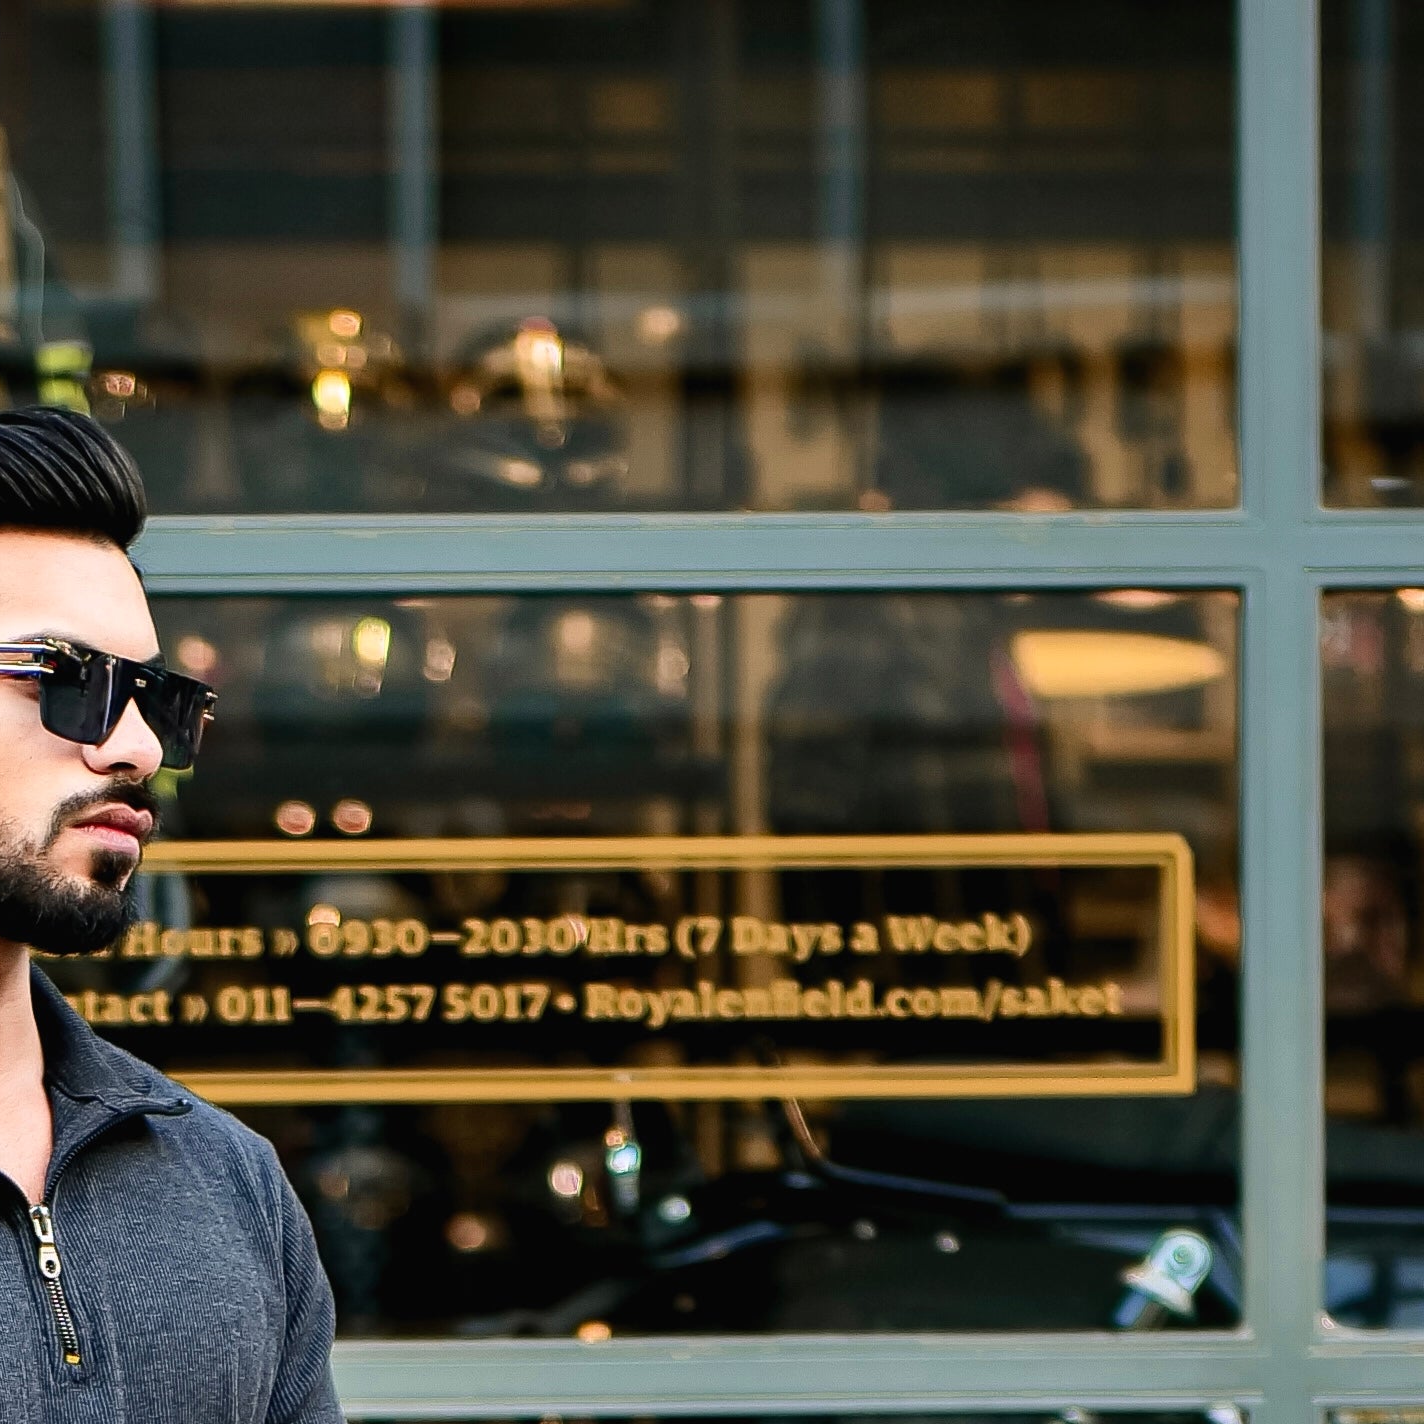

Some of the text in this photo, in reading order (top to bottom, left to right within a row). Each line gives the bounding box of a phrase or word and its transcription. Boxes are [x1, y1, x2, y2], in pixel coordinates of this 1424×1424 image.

[122, 920, 263, 957] Hours
[587, 916, 668, 954] Hrs
[677, 915, 722, 959] (7
[731, 915, 843, 962] Days
[850, 921, 879, 953] a
[886, 911, 1032, 957] Week)
